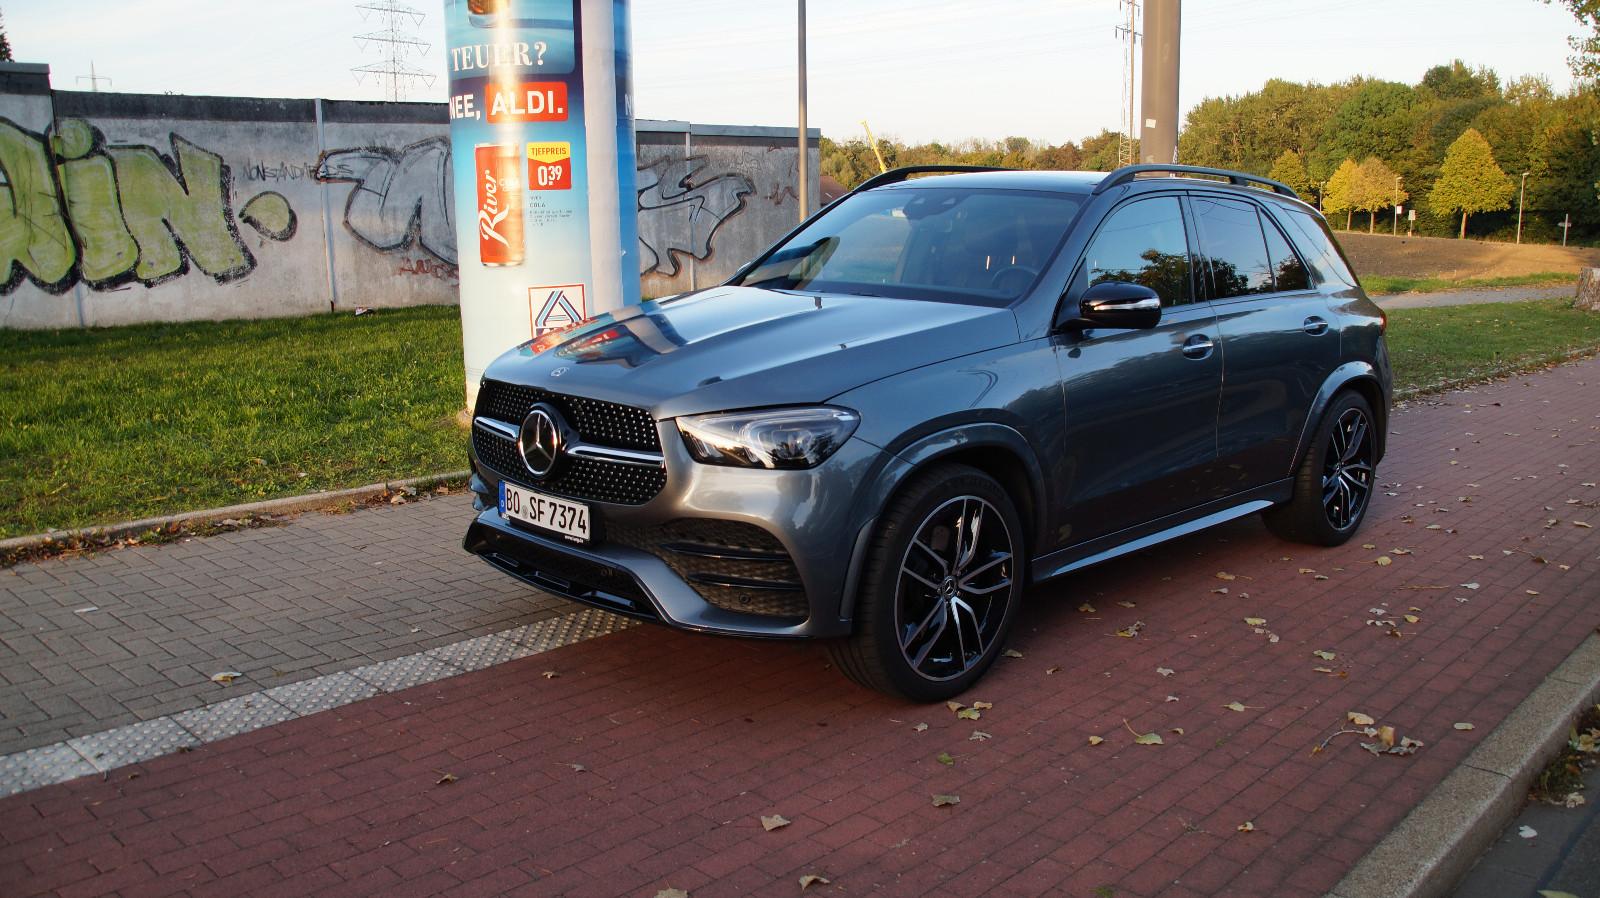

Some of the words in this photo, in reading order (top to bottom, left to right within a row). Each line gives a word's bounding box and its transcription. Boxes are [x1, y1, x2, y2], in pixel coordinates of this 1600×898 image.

[451, 41, 547, 71] TEUER?
[449, 93, 481, 120] NEE,
[490, 90, 564, 116] ALDI.
[531, 147, 567, 156] TIEFPREIS
[479, 169, 511, 248] River
[506, 487, 521, 515] BO
[529, 496, 546, 522] SF
[549, 502, 587, 534] 7374
